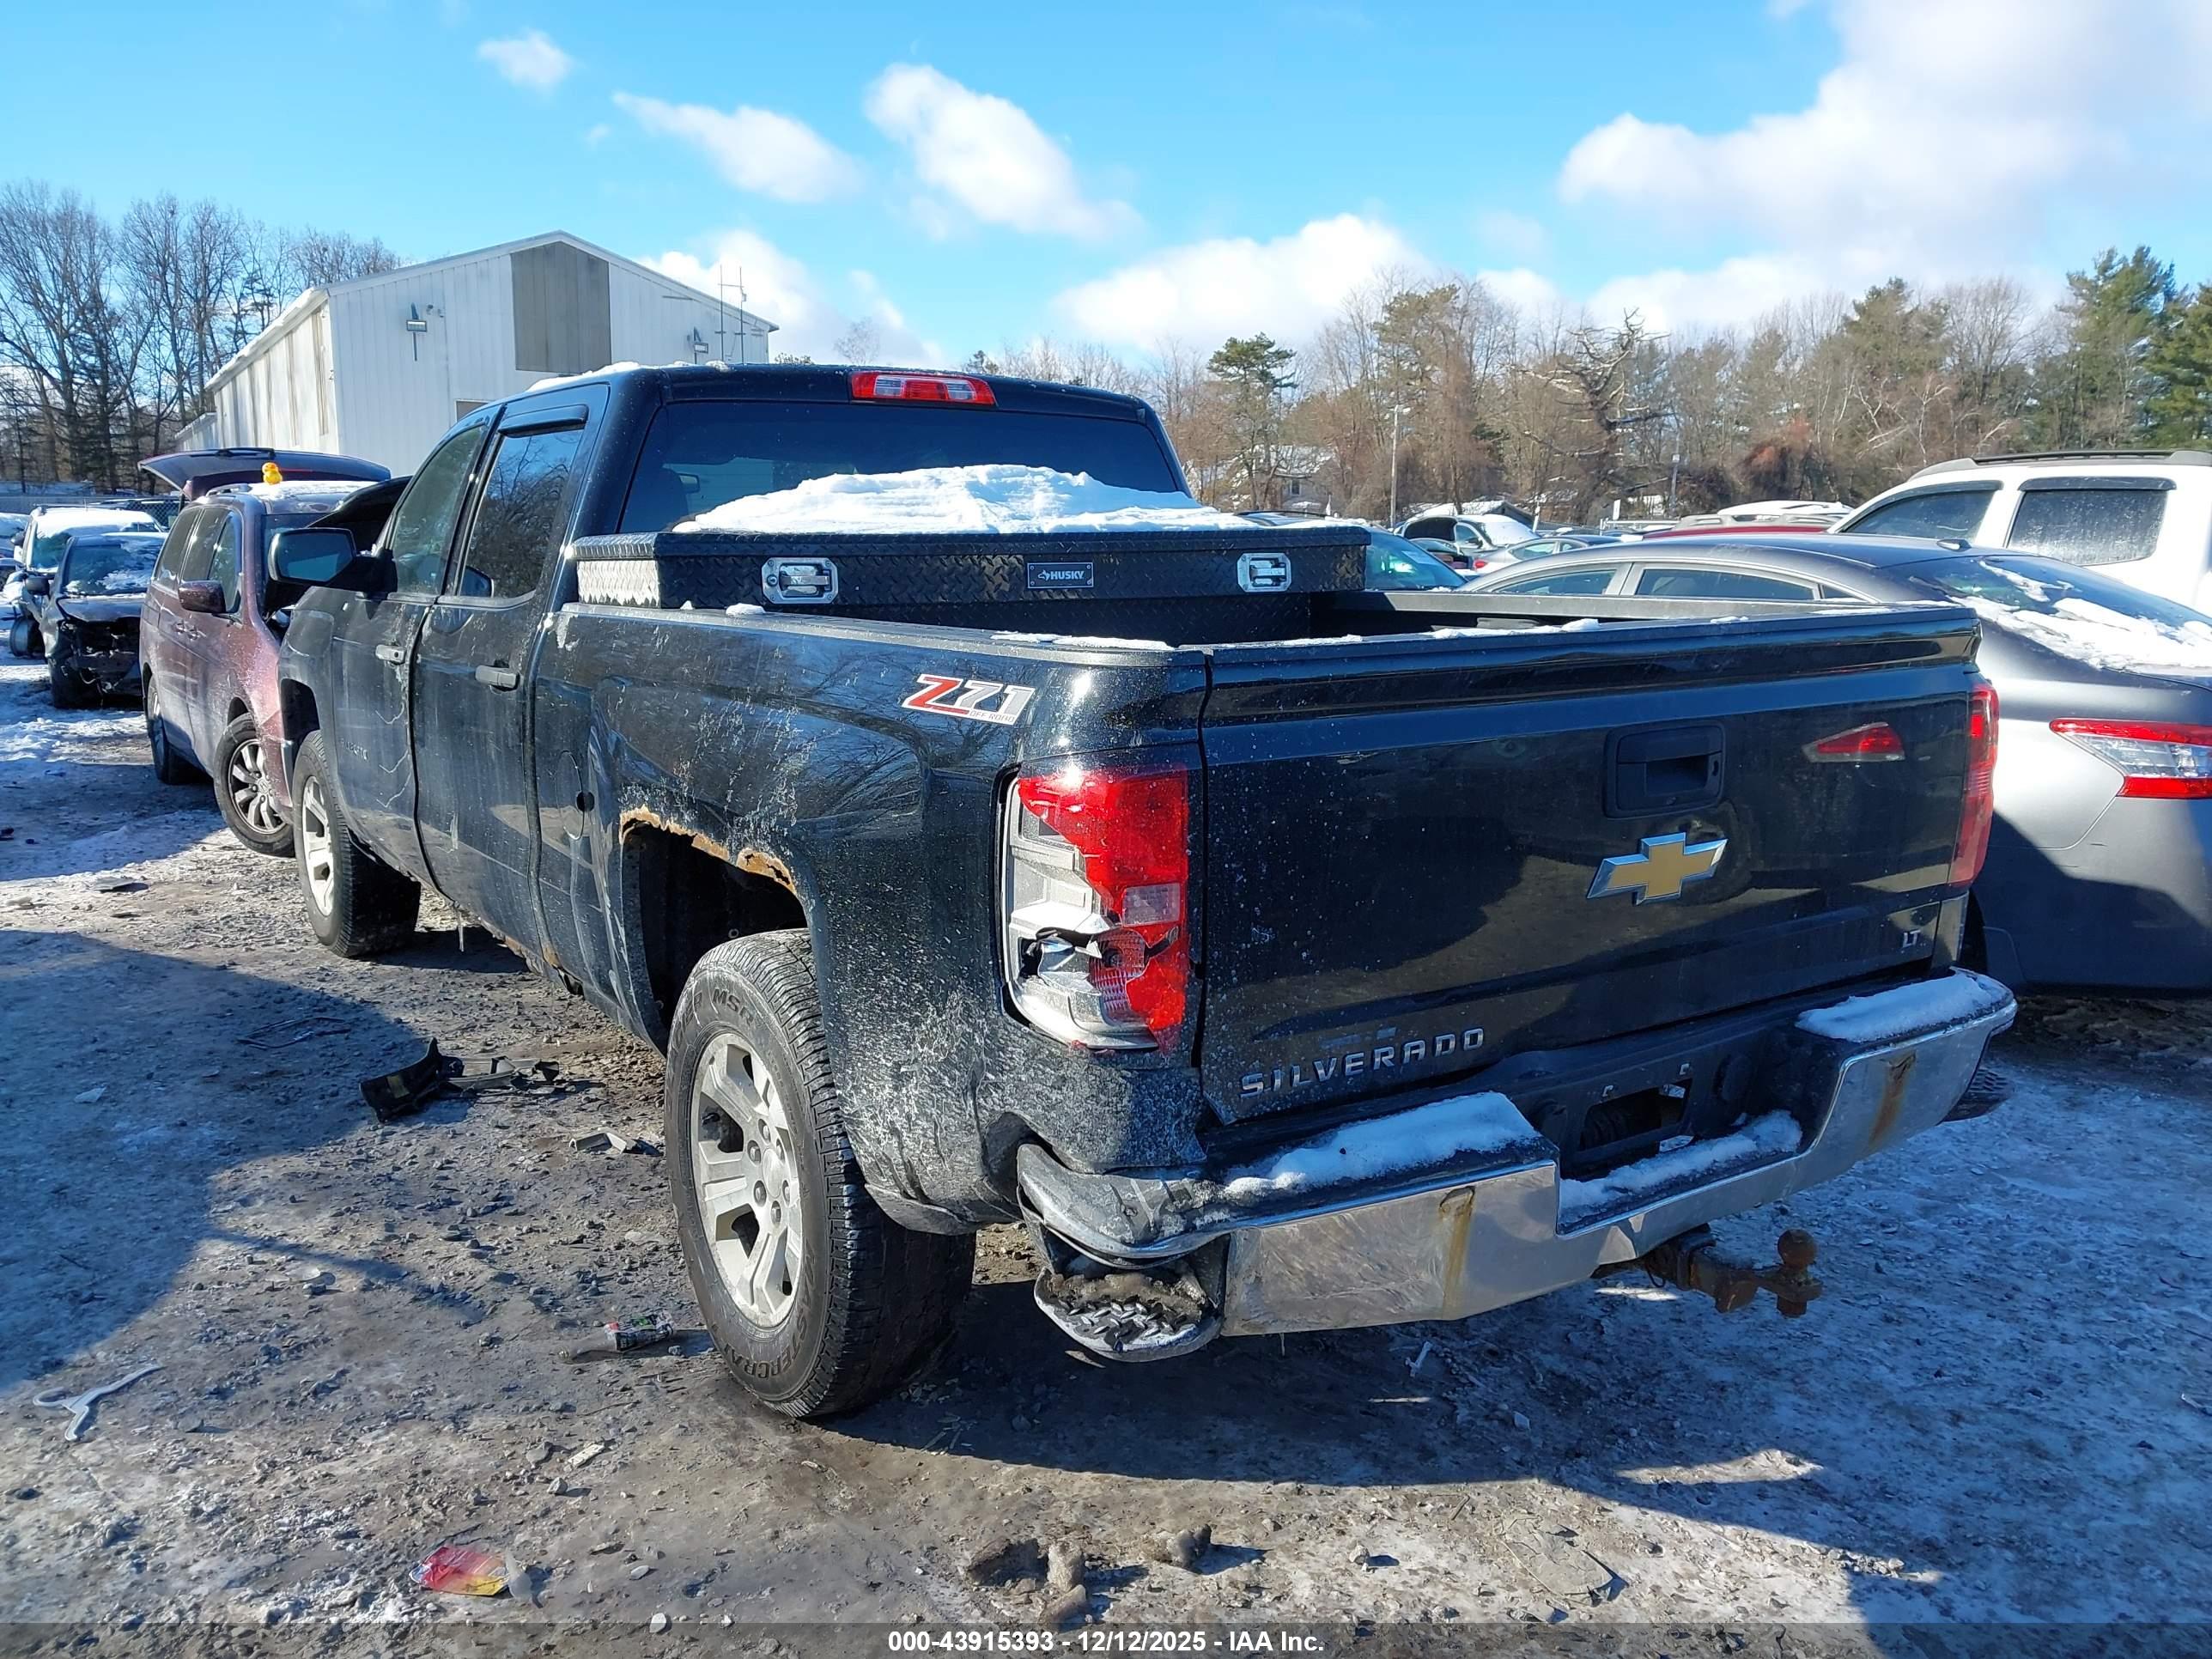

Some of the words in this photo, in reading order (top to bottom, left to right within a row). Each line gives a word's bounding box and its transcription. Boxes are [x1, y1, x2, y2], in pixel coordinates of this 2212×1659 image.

[1050, 570, 1085, 580] HUSKY
[902, 674, 1036, 724] Z71
[969, 710, 988, 719] OFF
[988, 714, 1016, 723] ROAD
[1902, 929, 1921, 949] LT
[1239, 1027, 1485, 1099] SILVERADO
